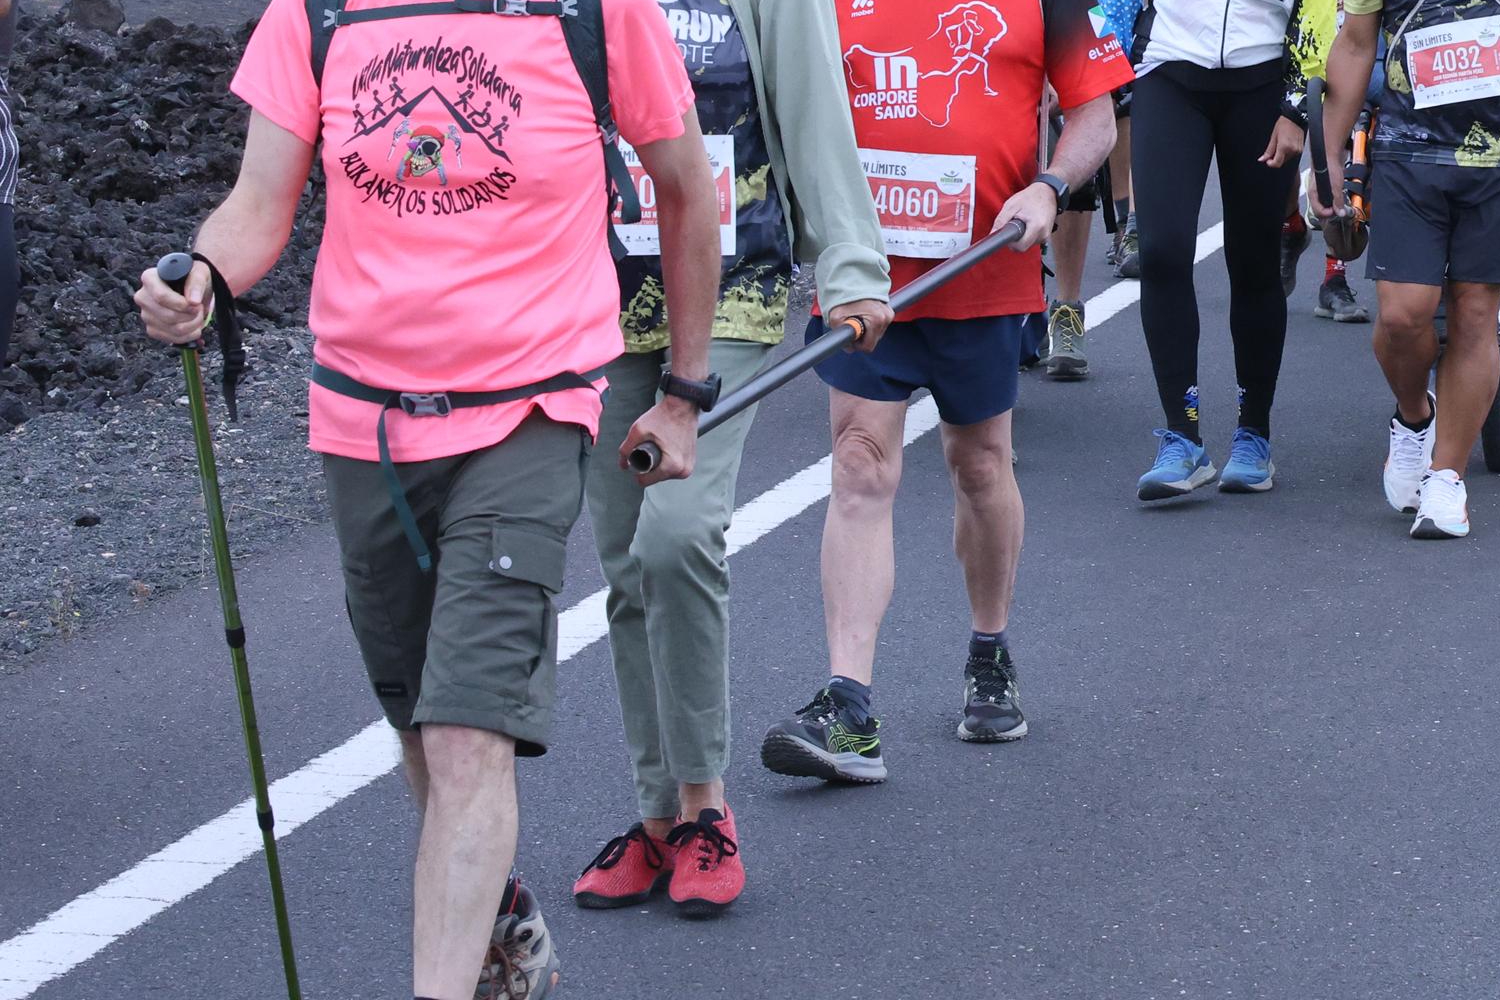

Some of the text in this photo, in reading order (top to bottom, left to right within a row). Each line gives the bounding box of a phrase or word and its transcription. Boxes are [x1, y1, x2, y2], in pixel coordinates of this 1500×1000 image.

[667, 9, 733, 43] RUN
[1413, 41, 1424, 50] SIN
[1432, 45, 1482, 74] 4032
[854, 89, 917, 108] CORPORE
[875, 104, 917, 120] SANO
[339, 151, 517, 218] BUKANEROS SOLIDARIOS
[874, 184, 939, 218] 4060
